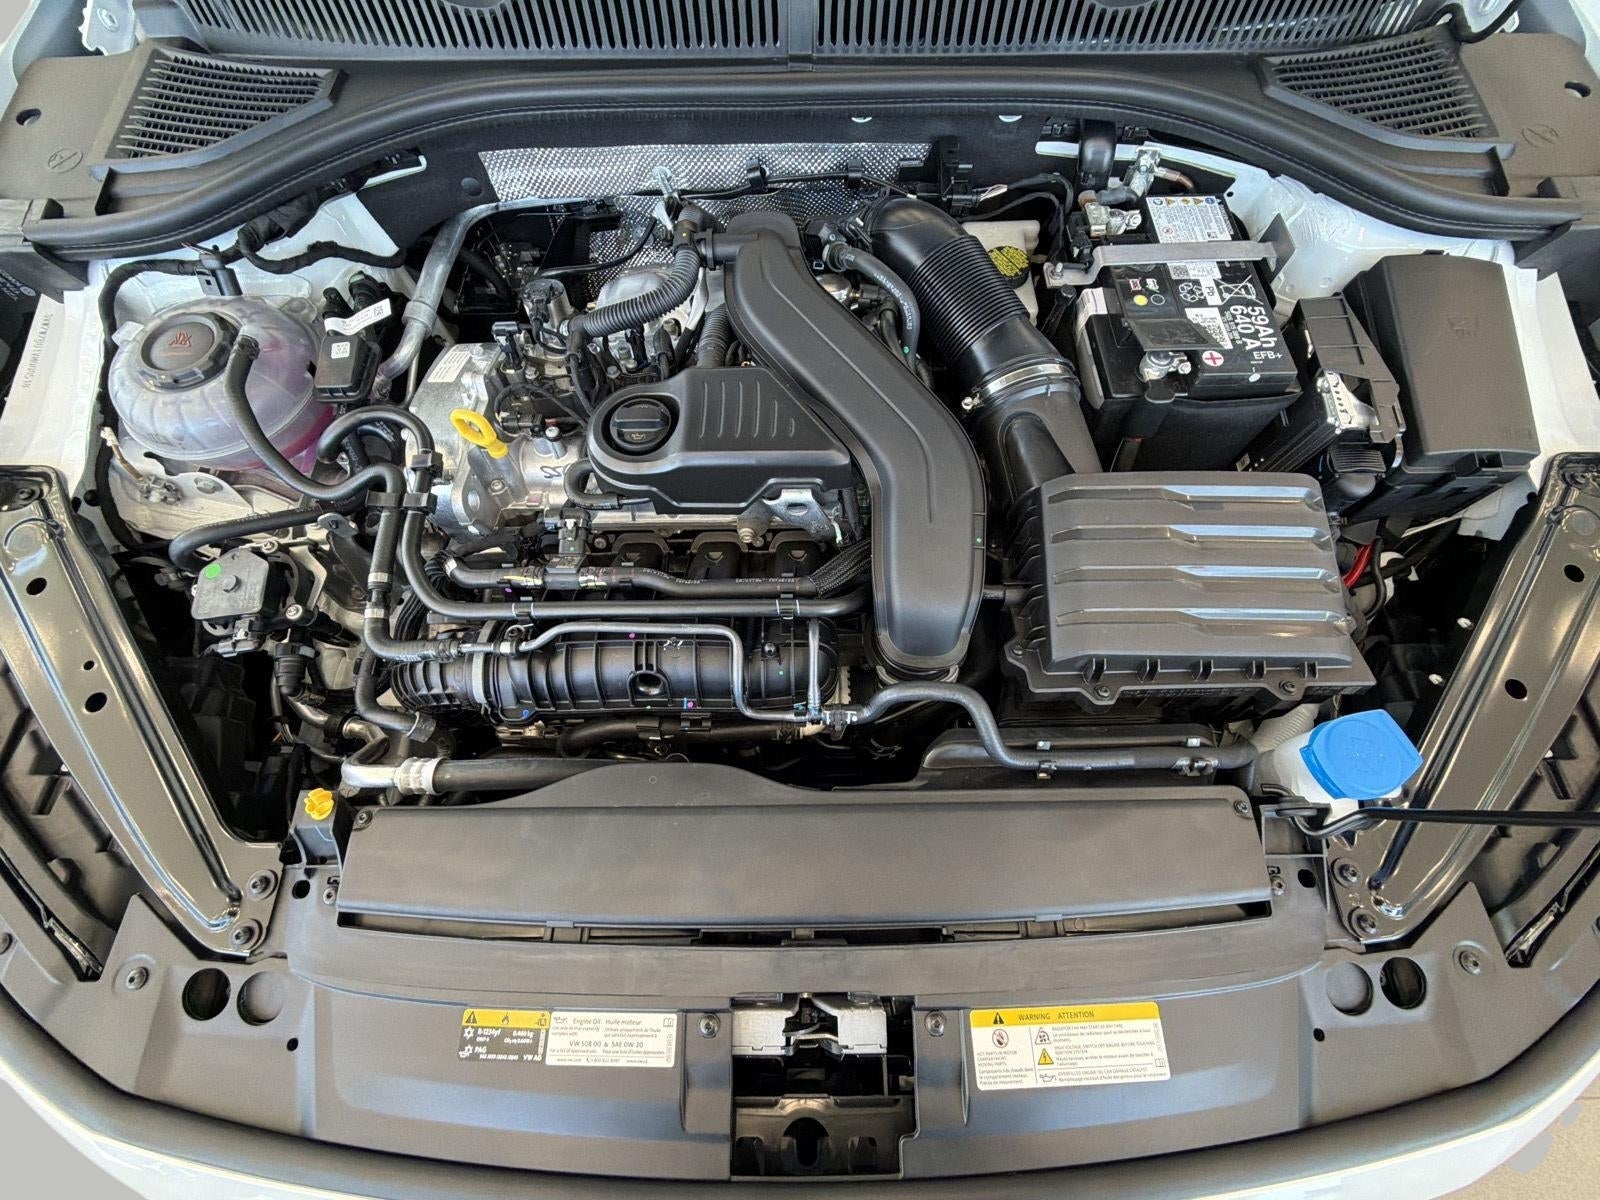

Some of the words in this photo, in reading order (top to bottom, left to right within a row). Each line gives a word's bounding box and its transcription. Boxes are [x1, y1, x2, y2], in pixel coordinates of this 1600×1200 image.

[1204, 286, 1215, 296] Pb
[1230, 305, 1254, 333] 640
[1242, 336, 1262, 351] A
[1248, 306, 1277, 348] 59Ah
[1252, 350, 1282, 360] EFB+
[1018, 1013, 1050, 1021] WARNING
[1058, 1011, 1094, 1019] ATTENTION
[477, 1028, 500, 1037] R-1234yf
[526, 1030, 533, 1038] kg
